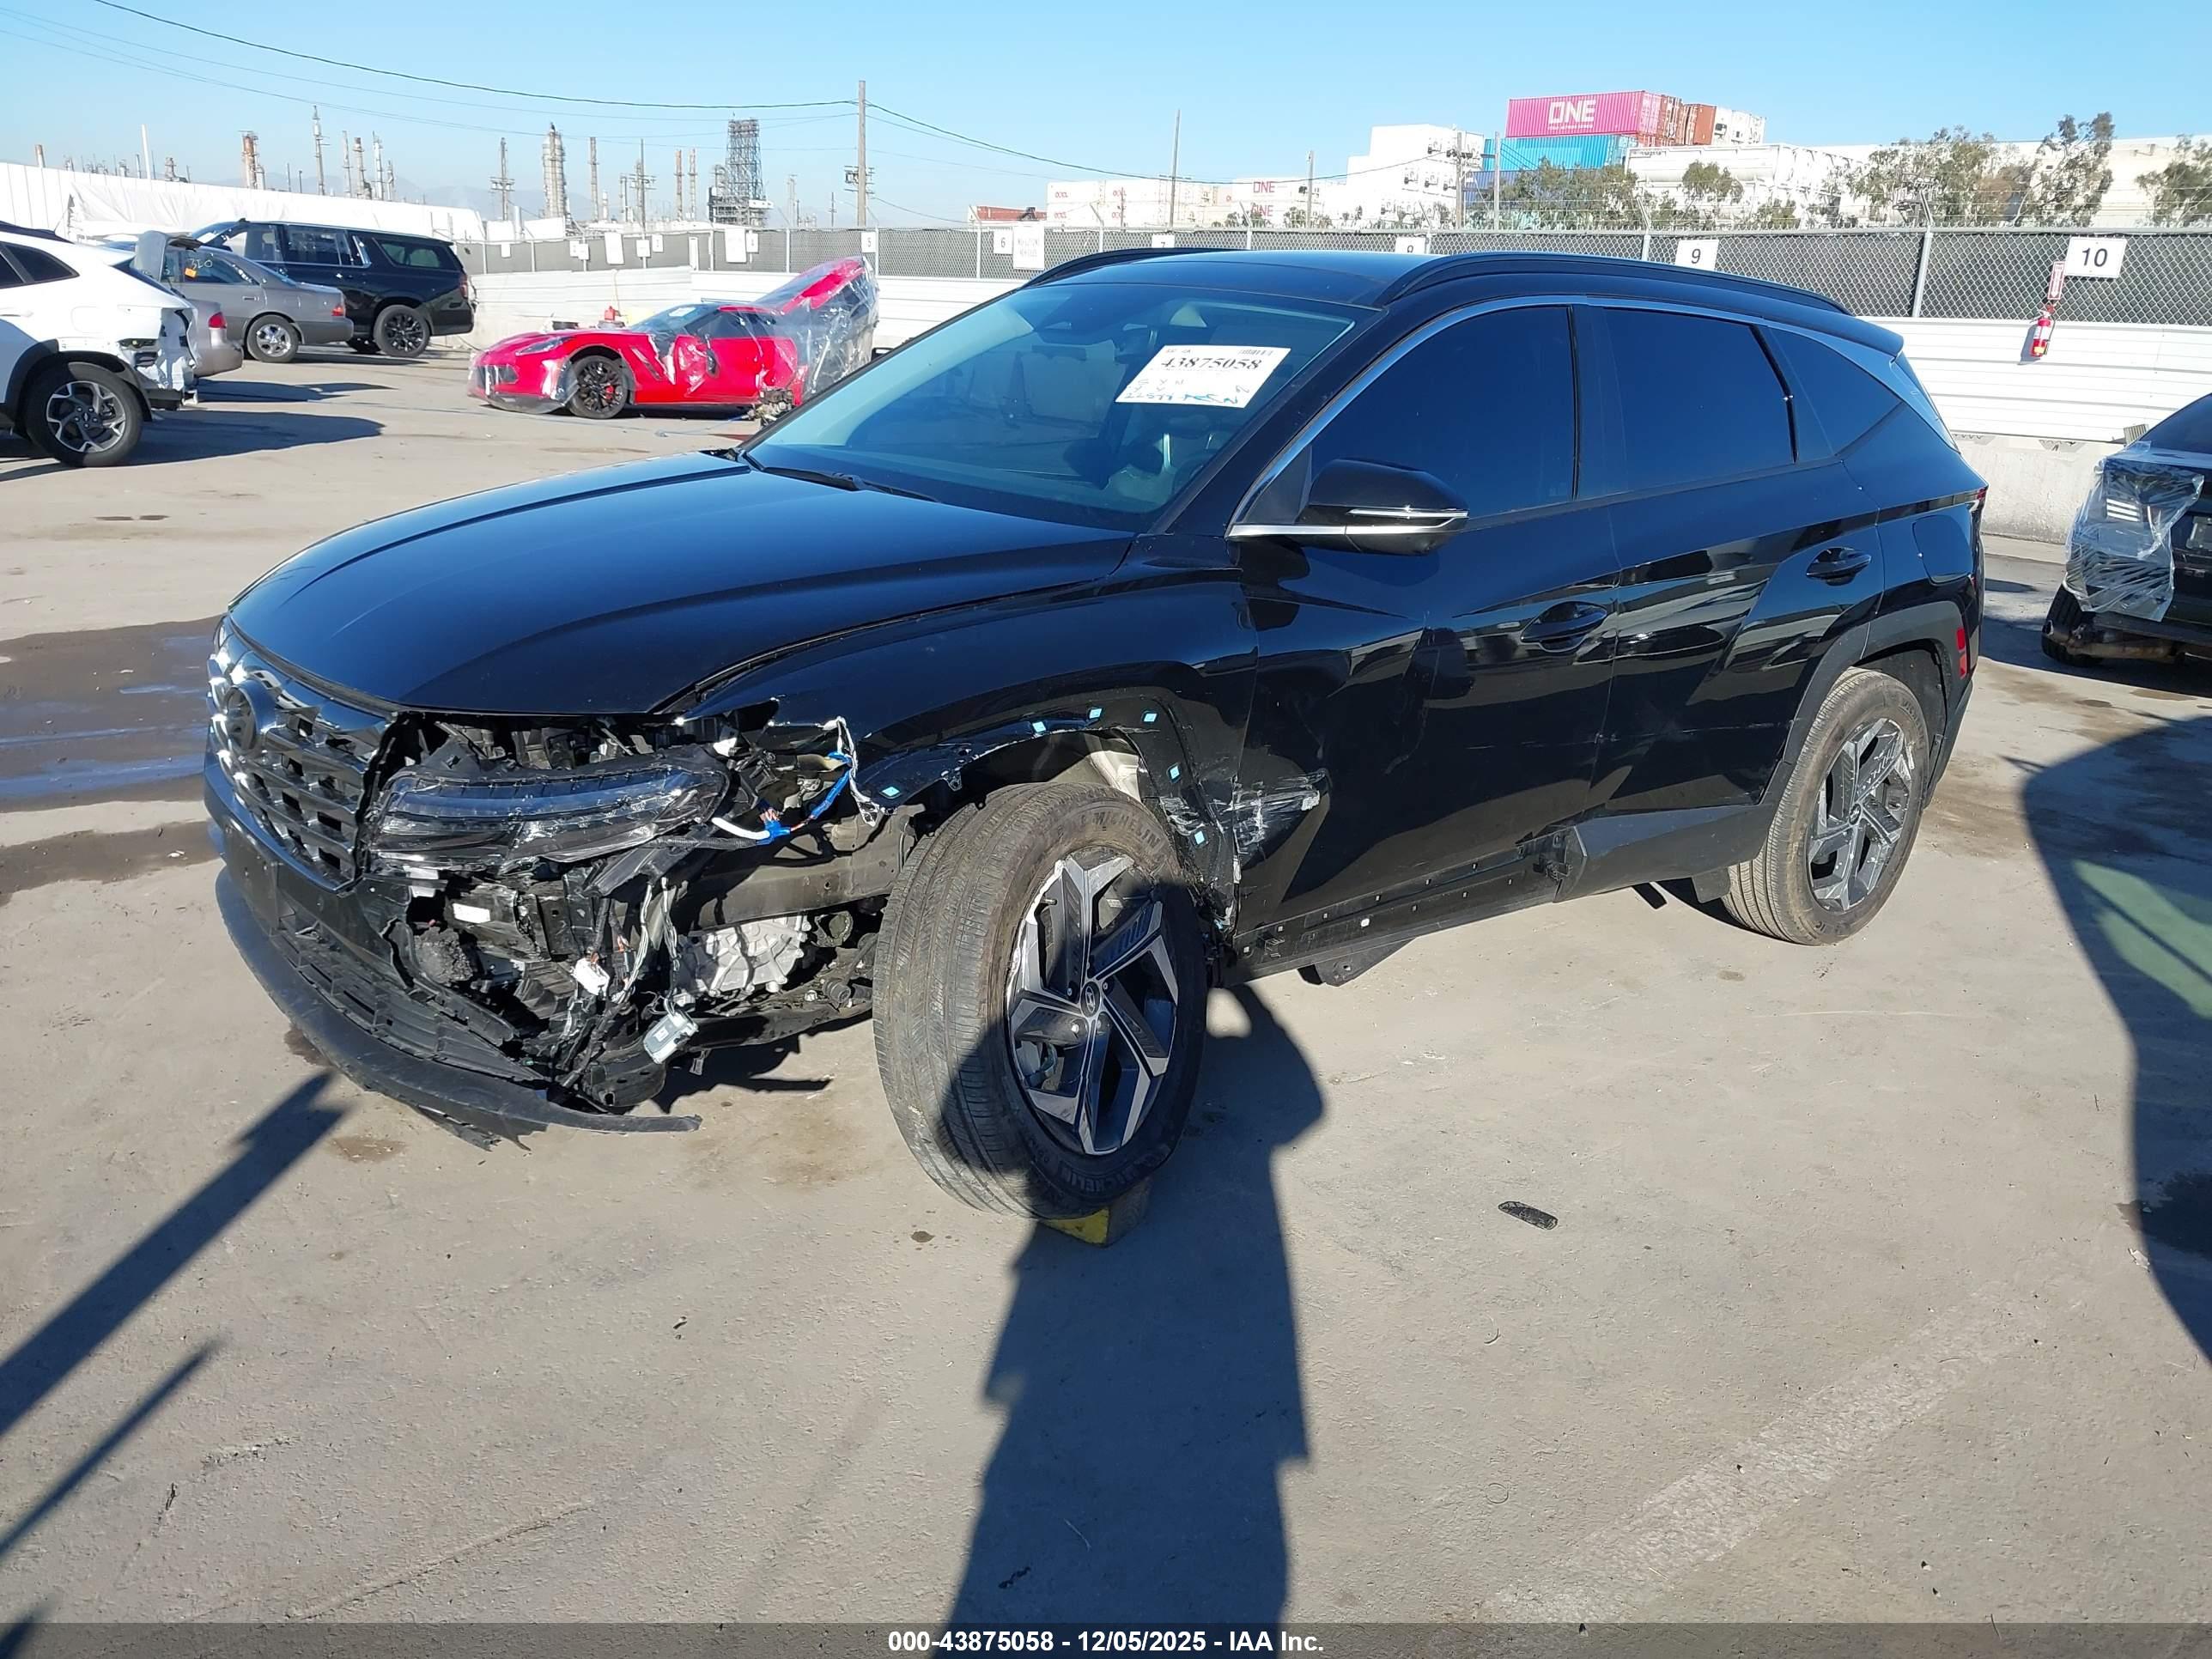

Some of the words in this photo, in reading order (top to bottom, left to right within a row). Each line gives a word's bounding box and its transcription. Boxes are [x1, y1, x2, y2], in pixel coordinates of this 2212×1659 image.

[1548, 100, 1596, 124] ONE
[1253, 181, 1275, 193] ONE
[1000, 237, 1006, 248] 6
[1691, 248, 1701, 264] 9
[2081, 247, 2108, 268] 10
[1161, 356, 1262, 370] 43875058
